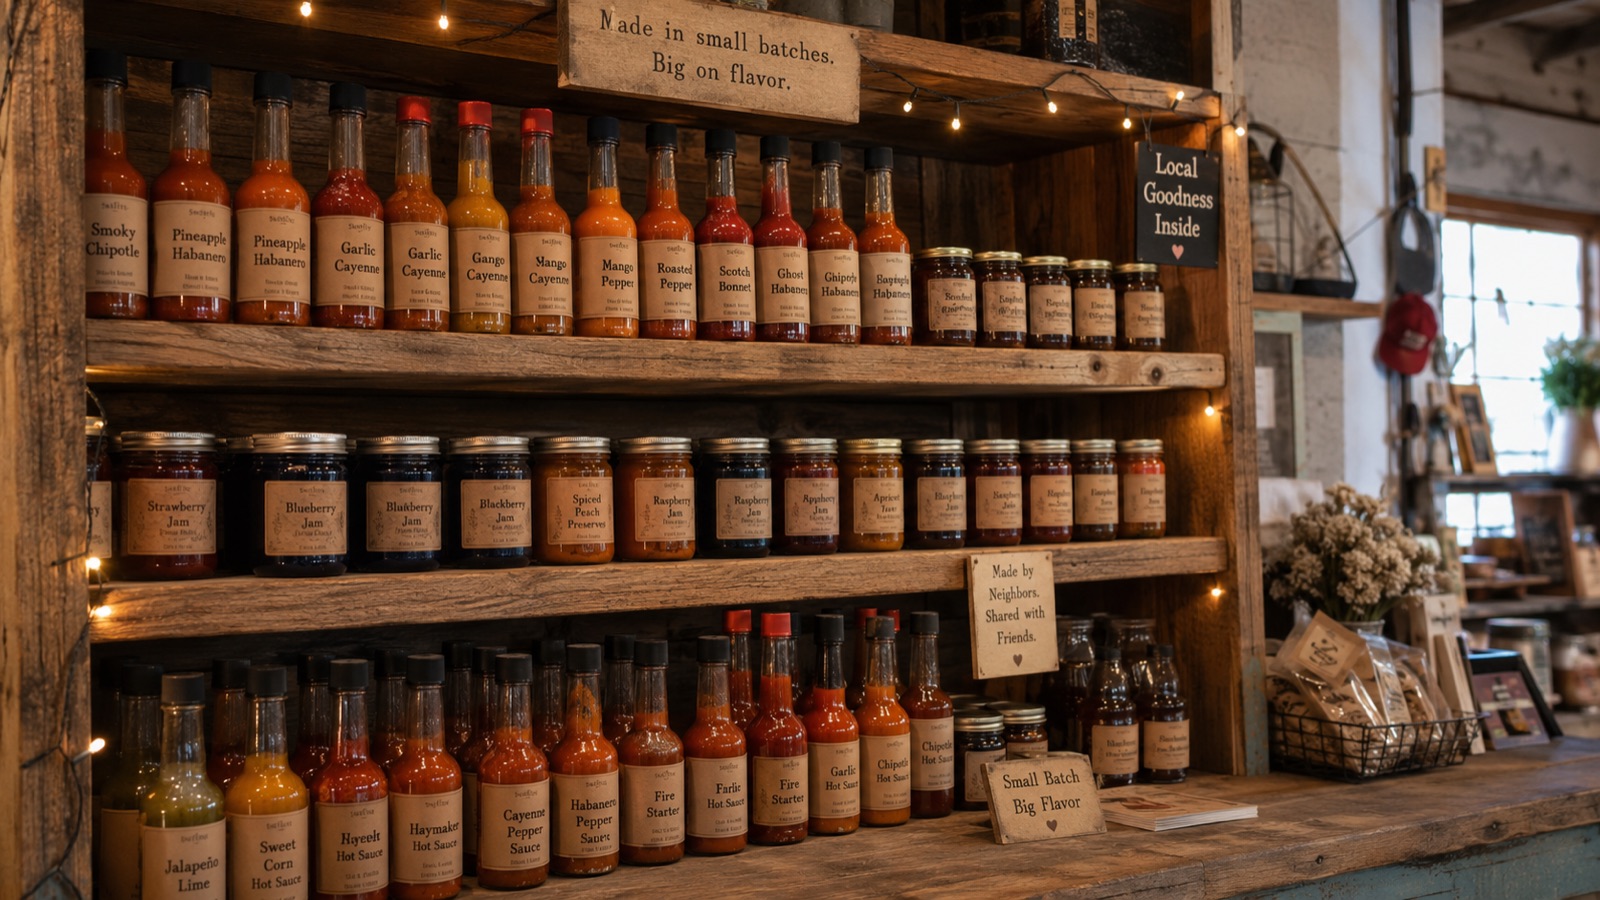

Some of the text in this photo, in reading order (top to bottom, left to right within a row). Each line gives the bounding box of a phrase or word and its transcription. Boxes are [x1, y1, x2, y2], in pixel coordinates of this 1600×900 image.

[600, 9, 835, 64] Made in small batches.
[652, 51, 791, 91] Big on flavor.
[1155, 152, 1198, 178] Local
[1143, 182, 1213, 210] Goodness
[91, 223, 136, 241] Smoky
[1155, 213, 1200, 238] Inside
[172, 229, 226, 246] Pineapple
[254, 235, 306, 252] Pineapple
[86, 242, 139, 258] Chipotle
[172, 247, 226, 264] Habanero
[341, 242, 376, 256] Garlic
[408, 247, 442, 261] Garlic
[254, 253, 306, 269] Habanero
[472, 252, 505, 267] Gango
[602, 259, 634, 274] Mango
[334, 259, 380, 275] Cayenne
[402, 265, 446, 280] Cayenne
[657, 262, 693, 275] Roasted
[719, 266, 751, 277] Scotch
[777, 268, 804, 279] Ghost
[466, 269, 508, 283] Cayenne
[529, 272, 569, 286] Cayenne
[601, 275, 634, 290] Pepper
[660, 278, 692, 292] Pepper
[719, 281, 751, 292] Bonnet
[148, 501, 206, 514] Strawberry
[479, 499, 526, 511] Blackberry
[572, 494, 602, 507] Spiced
[653, 495, 691, 508] Raspberry
[285, 502, 336, 516] Blueberry
[575, 507, 600, 517] Peach
[667, 508, 683, 518] Jam
[167, 516, 190, 528] Jam
[301, 517, 324, 529] Jam
[402, 515, 422, 527] Jam
[496, 512, 515, 523] Jam
[567, 519, 606, 530] Preserves
[992, 563, 1034, 579] Made by
[989, 587, 1040, 603] Neighbors.
[985, 607, 1045, 622] Shared with
[997, 630, 1036, 644] Friends.
[921, 755, 937, 764] Hot
[831, 766, 856, 777] Garlic
[876, 774, 891, 783] Hot
[780, 779, 800, 791] Fire
[825, 780, 841, 791] Hot
[1003, 769, 1080, 789] Small Batch
[654, 791, 675, 802] Fire
[771, 793, 804, 805] Starter
[571, 798, 617, 811] Habanero
[707, 798, 724, 810] Hot
[1013, 795, 1080, 816] Big Flavor
[503, 808, 546, 824] Cayenne
[647, 806, 680, 818] Starter
[410, 821, 459, 838] Haymaker
[576, 815, 613, 830] Pepper
[507, 825, 543, 840] Pepper
[260, 840, 296, 854] Sweet
[413, 838, 457, 852] Hot Sauce
[510, 843, 541, 855] Sauce
[337, 848, 383, 862] Hot Sauce
[165, 856, 218, 875] Jalapeño
[264, 859, 293, 872] Corn
[178, 878, 210, 892] Lime
[251, 875, 302, 890] Hot Sauce
